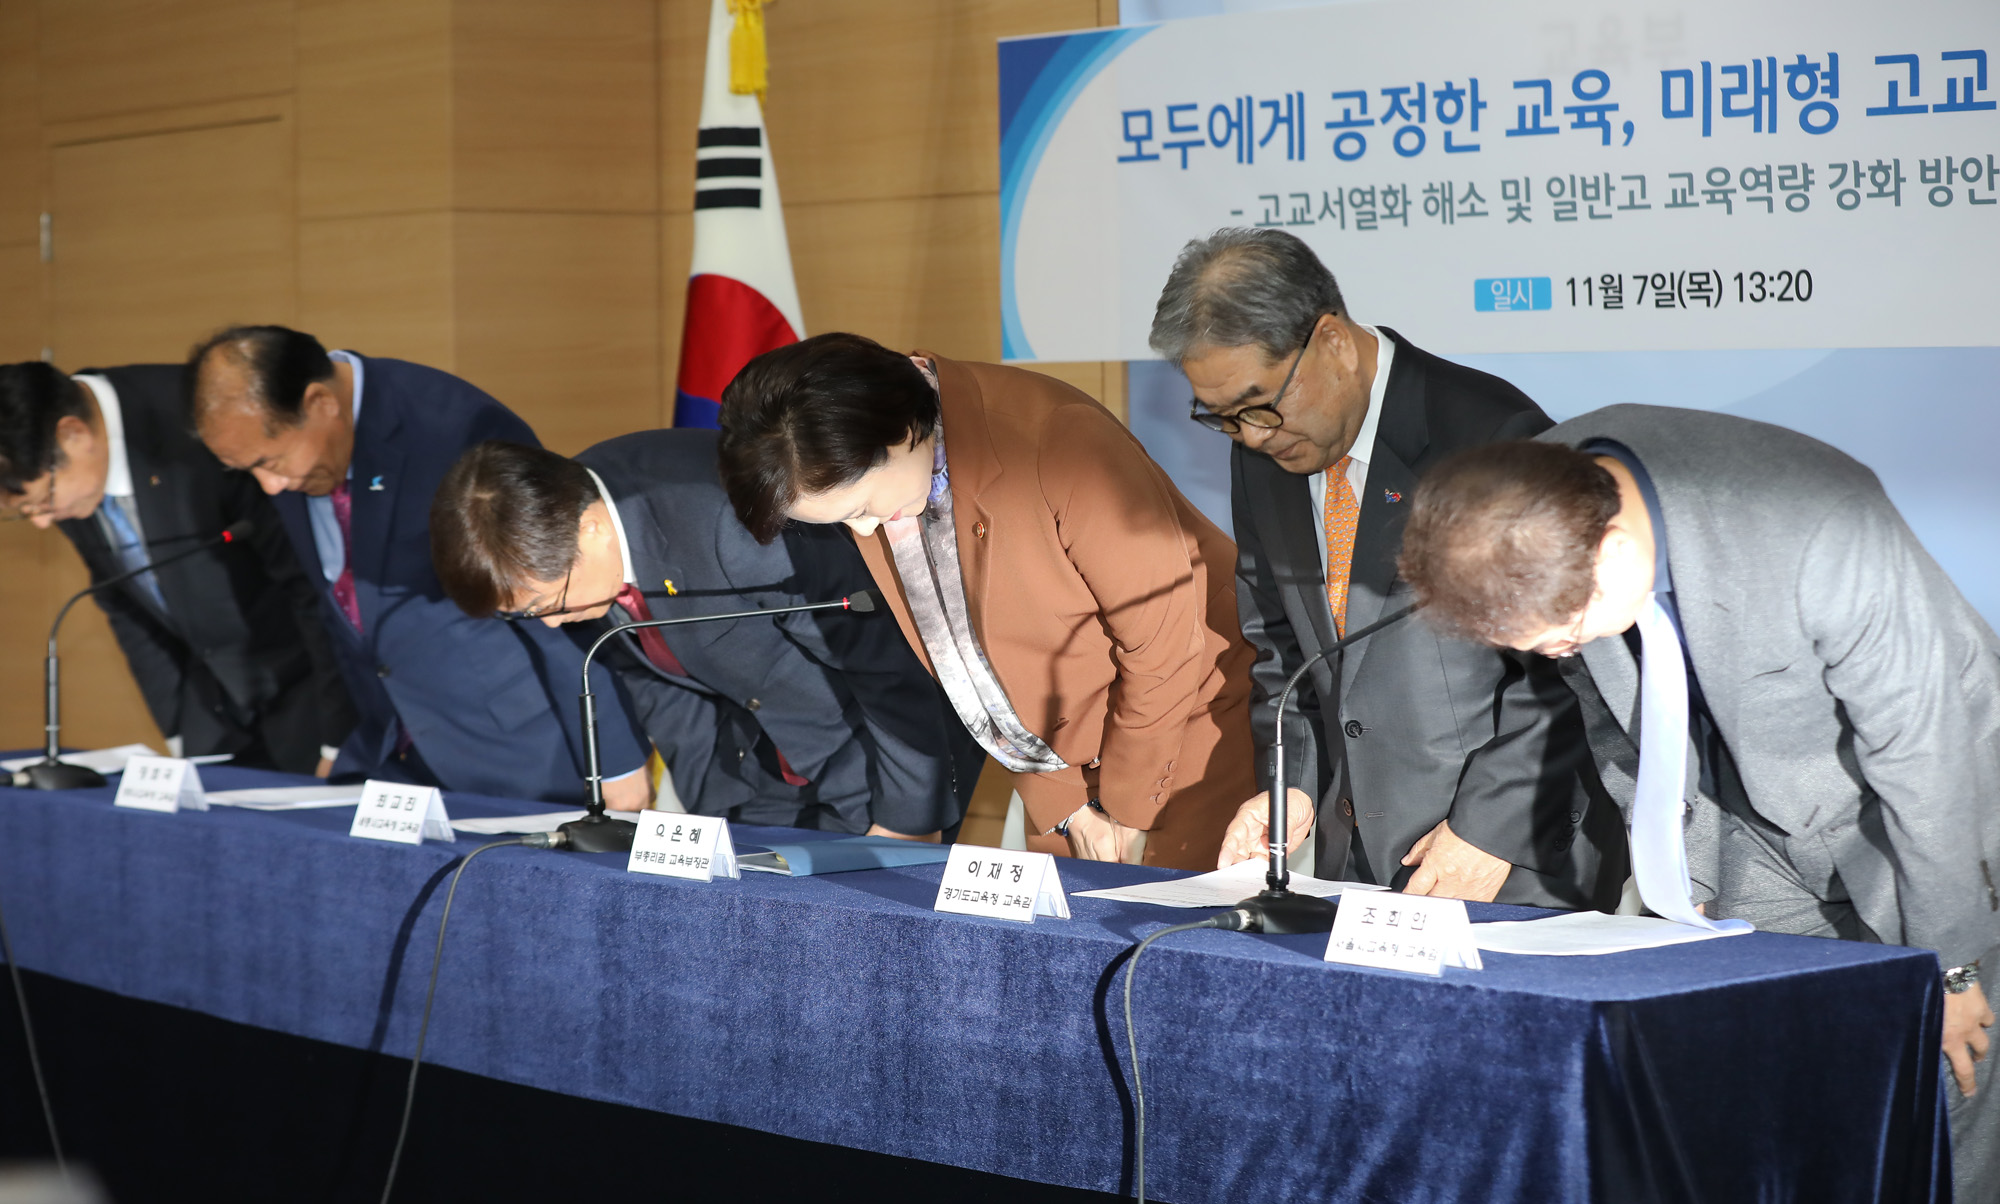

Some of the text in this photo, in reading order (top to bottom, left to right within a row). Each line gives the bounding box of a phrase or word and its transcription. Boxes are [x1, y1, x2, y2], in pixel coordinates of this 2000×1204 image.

[1116, 48, 1998, 171] 모두에게 공정한 교육, 미래형 고교
[1253, 183, 1413, 231] 고교서열화
[1421, 180, 1490, 226] 해소
[1500, 176, 1533, 224] 및
[1545, 172, 1652, 223] 일반고
[1664, 162, 1816, 216] 교육역량
[1828, 157, 1907, 211] 강화
[1918, 153, 2000, 208] 방안
[1489, 268, 1814, 311] 일시 11월 7일(목) 13:20
[967, 860, 1024, 883] 이재정
[943, 887, 1033, 909] 경기도교육청 교육감
